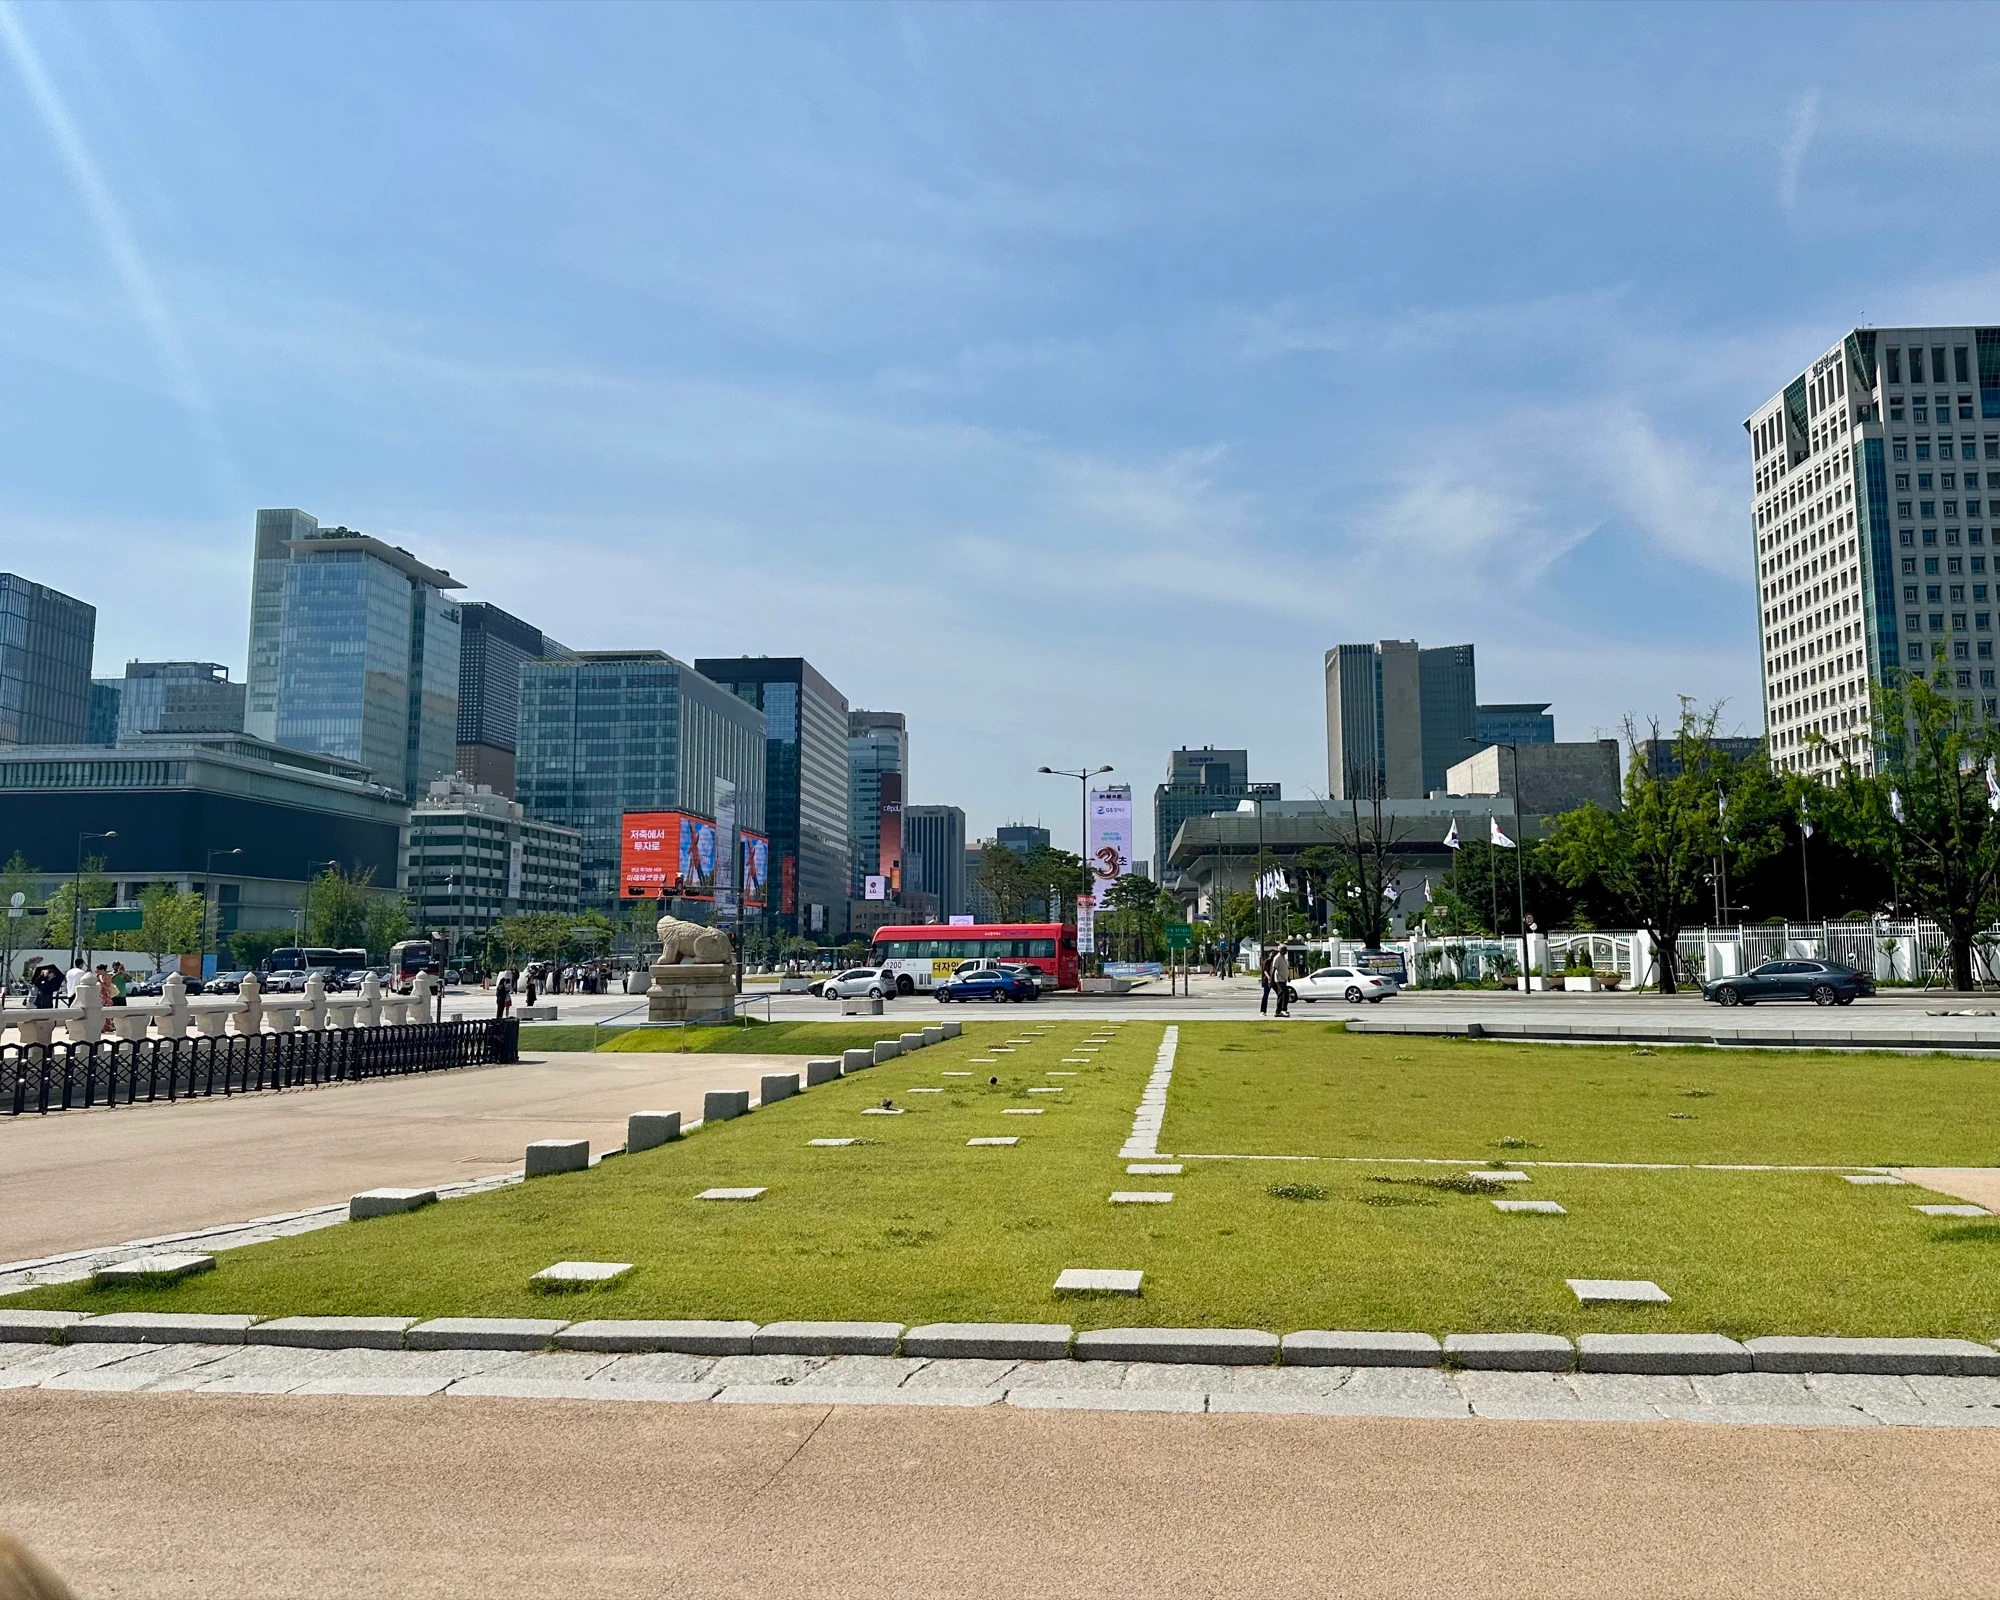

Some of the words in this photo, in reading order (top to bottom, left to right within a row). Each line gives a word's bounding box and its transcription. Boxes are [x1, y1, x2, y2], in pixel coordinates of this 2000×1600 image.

[630, 829, 665, 840] 저축에서
[634, 841, 660, 851] 투자로
[886, 961, 902, 969] 1200
